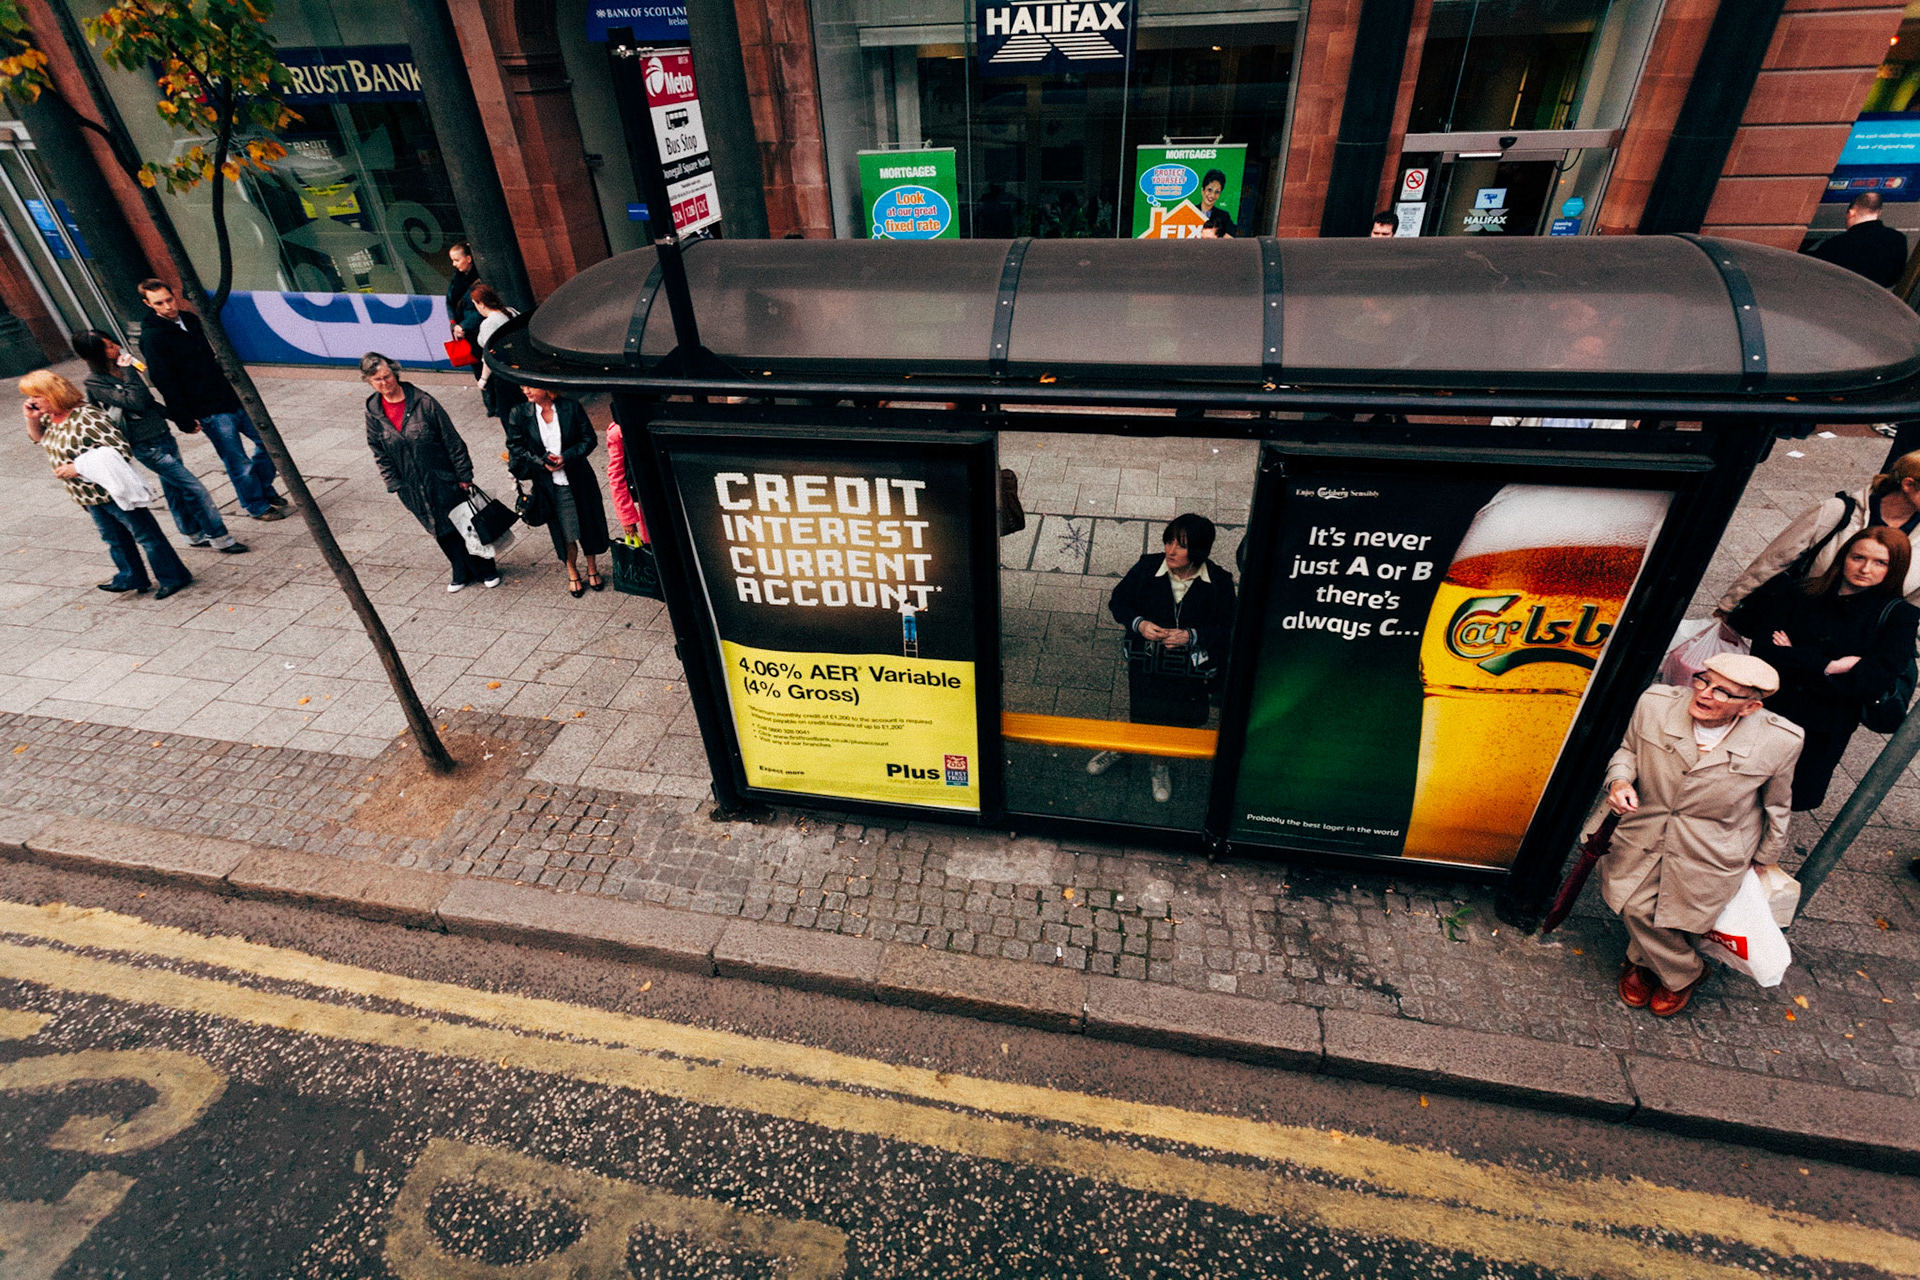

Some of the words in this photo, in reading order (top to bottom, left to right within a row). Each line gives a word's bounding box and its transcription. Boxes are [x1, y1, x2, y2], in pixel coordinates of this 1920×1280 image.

[606, 8, 631, 18] BANK
[631, 7, 642, 17] OF
[986, 2, 1126, 36] HALIFAX
[347, 59, 423, 93] BANK
[664, 71, 694, 95] Metro
[665, 137, 681, 155] Bus
[681, 134, 697, 152] Stop
[1165, 149, 1217, 159] MORTGAGES
[682, 161, 699, 174] Square
[879, 165, 937, 179] MORTGAGES
[1154, 169, 1186, 177] PROTECT
[1152, 176, 1187, 185] YOURSELF
[896, 191, 925, 205] Look
[886, 206, 896, 217] at
[897, 207, 912, 217] our
[914, 205, 937, 218] great
[1463, 216, 1508, 225] HALIFAX
[885, 218, 914, 232] fixed
[916, 218, 941, 232] rate
[714, 472, 926, 516] CREDIT
[1317, 487, 1349, 499] Carlsberg
[1350, 490, 1379, 498] Sensibly
[721, 514, 929, 548] INTEREST
[1353, 531, 1432, 551] never
[729, 546, 932, 582] CURRENT
[1289, 554, 1340, 579] just
[1345, 556, 1370, 576] A
[1376, 563, 1407, 580] or
[1412, 561, 1434, 581] B
[1282, 611, 1372, 640] always
[738, 657, 802, 680] 4.06%
[868, 666, 961, 689] Variable
[744, 676, 781, 698] (4%
[787, 684, 860, 706] Gross)
[759, 765, 784, 775] Expect
[886, 763, 940, 780] Plus
[1247, 813, 1285, 825] Probably
[1286, 819, 1301, 827] the
[1302, 821, 1321, 829] best
[1323, 823, 1345, 832] lager
[1357, 826, 1372, 834] the
[1373, 829, 1400, 837] world
